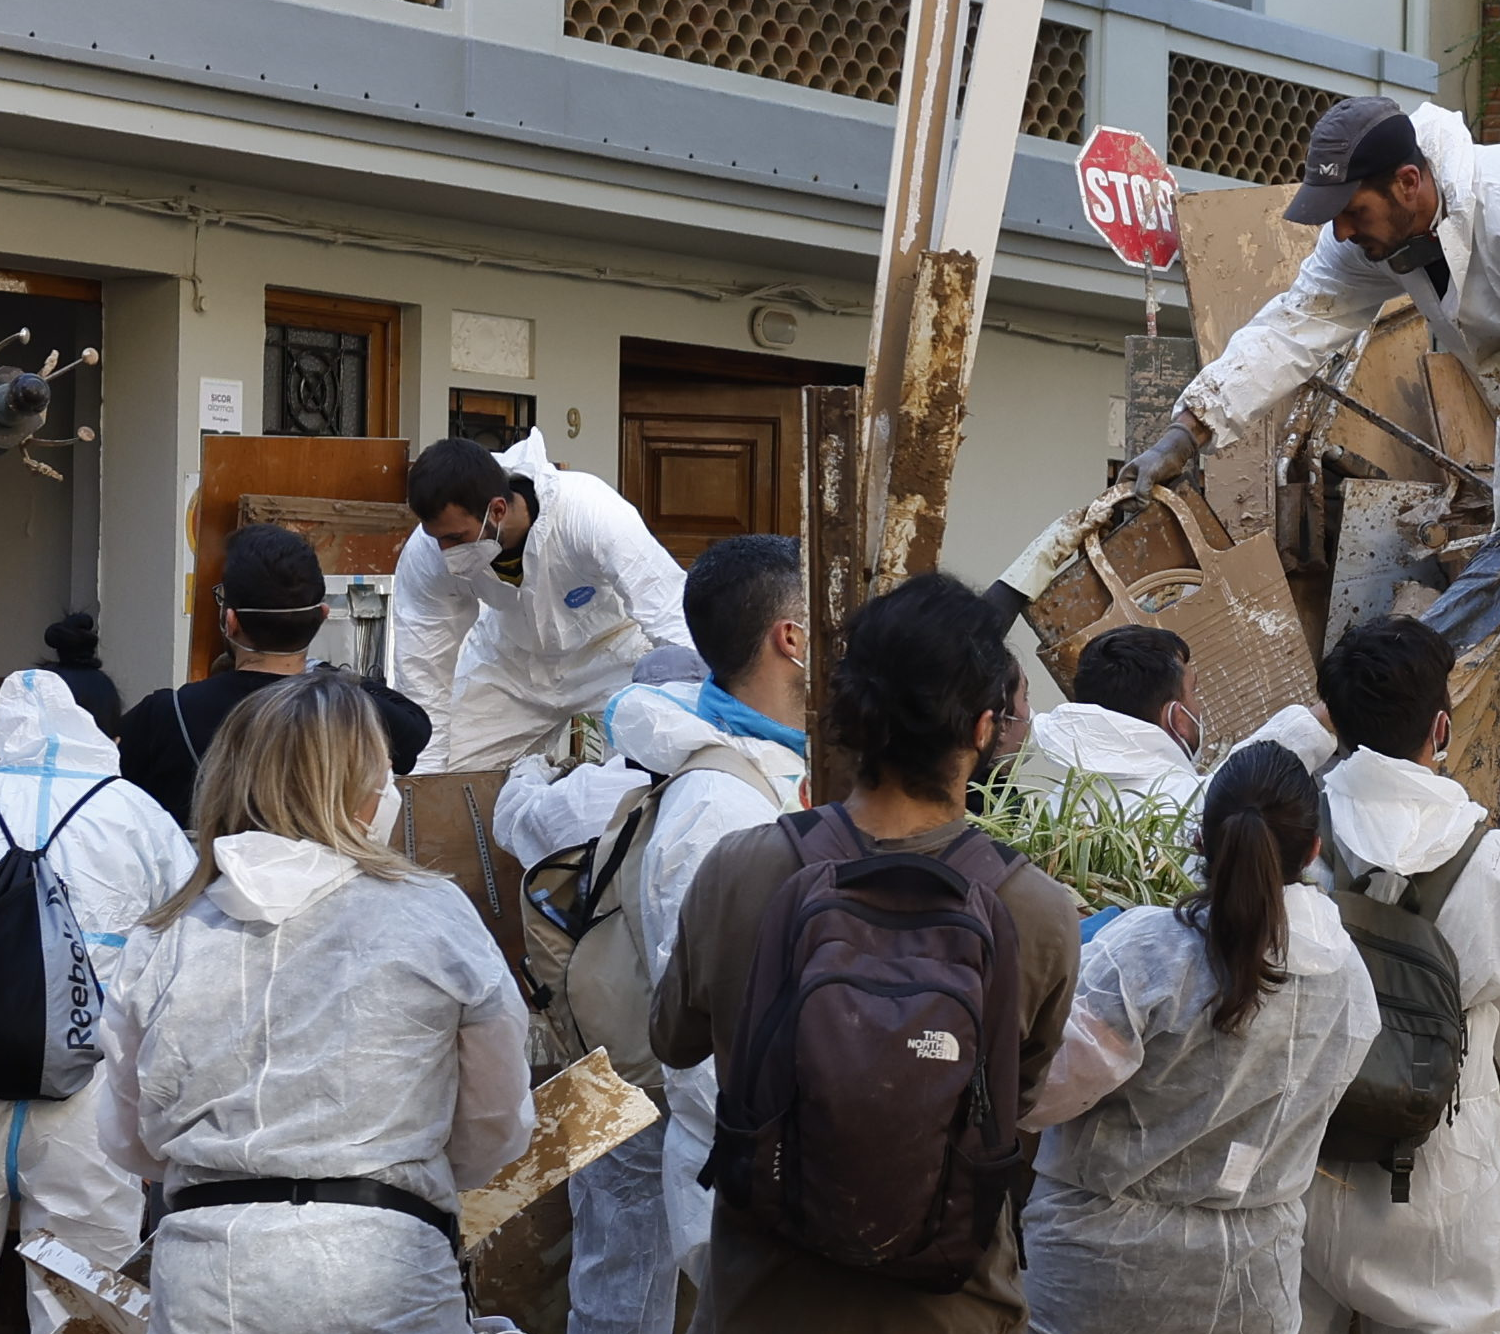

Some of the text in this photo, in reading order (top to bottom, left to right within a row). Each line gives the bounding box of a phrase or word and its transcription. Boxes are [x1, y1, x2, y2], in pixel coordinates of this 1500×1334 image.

[1085, 166, 1175, 233] STOP
[566, 407, 581, 439] 9
[923, 1030, 945, 1041] THE
[907, 1038, 943, 1050] NORTH
[916, 1048, 944, 1059] FACE
